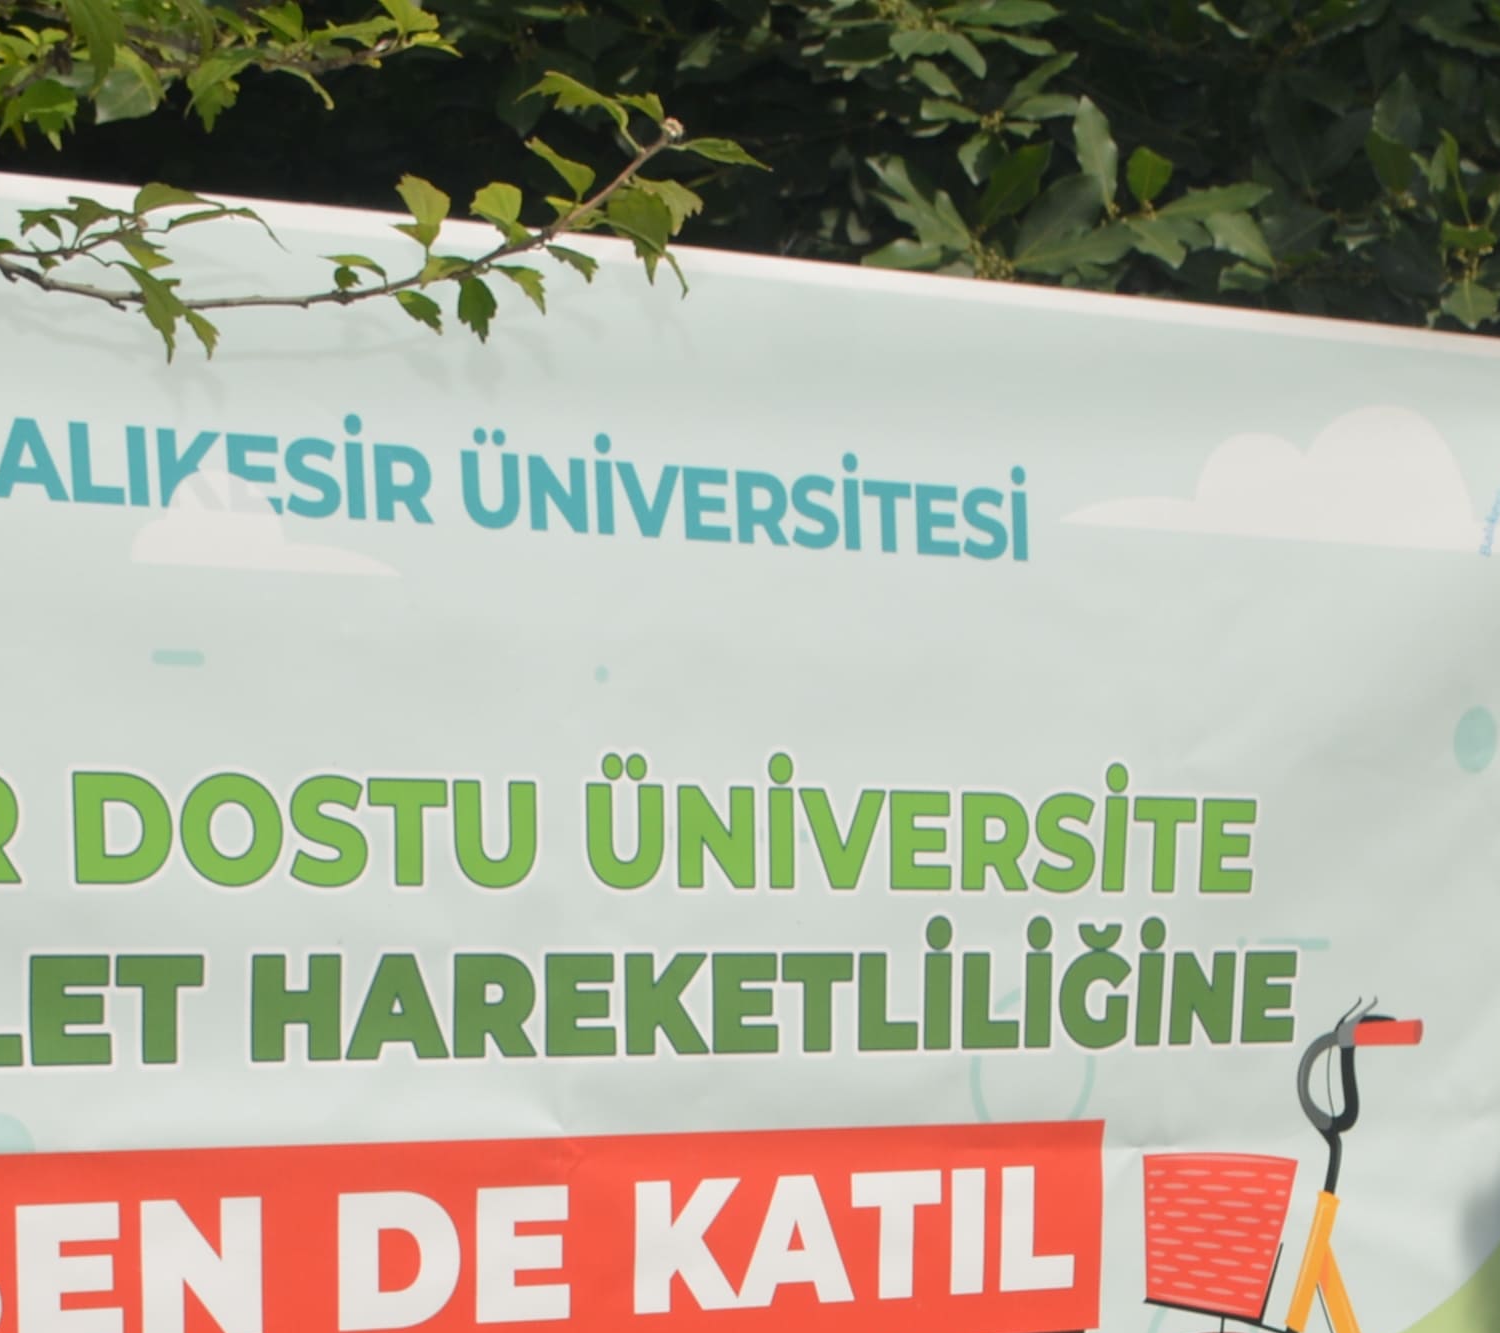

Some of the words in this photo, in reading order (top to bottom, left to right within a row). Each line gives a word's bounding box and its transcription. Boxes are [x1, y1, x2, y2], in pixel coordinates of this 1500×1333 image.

[461, 430, 1030, 562] ÜNİVERSİTESİ
[70, 769, 539, 889] DOSTU
[583, 750, 1258, 894] ÜNİVERSİTE
[248, 915, 1299, 1063] HAREKETLİLİĞİNE
[334, 1185, 573, 1332] DE
[631, 1165, 1077, 1314] KATIL
